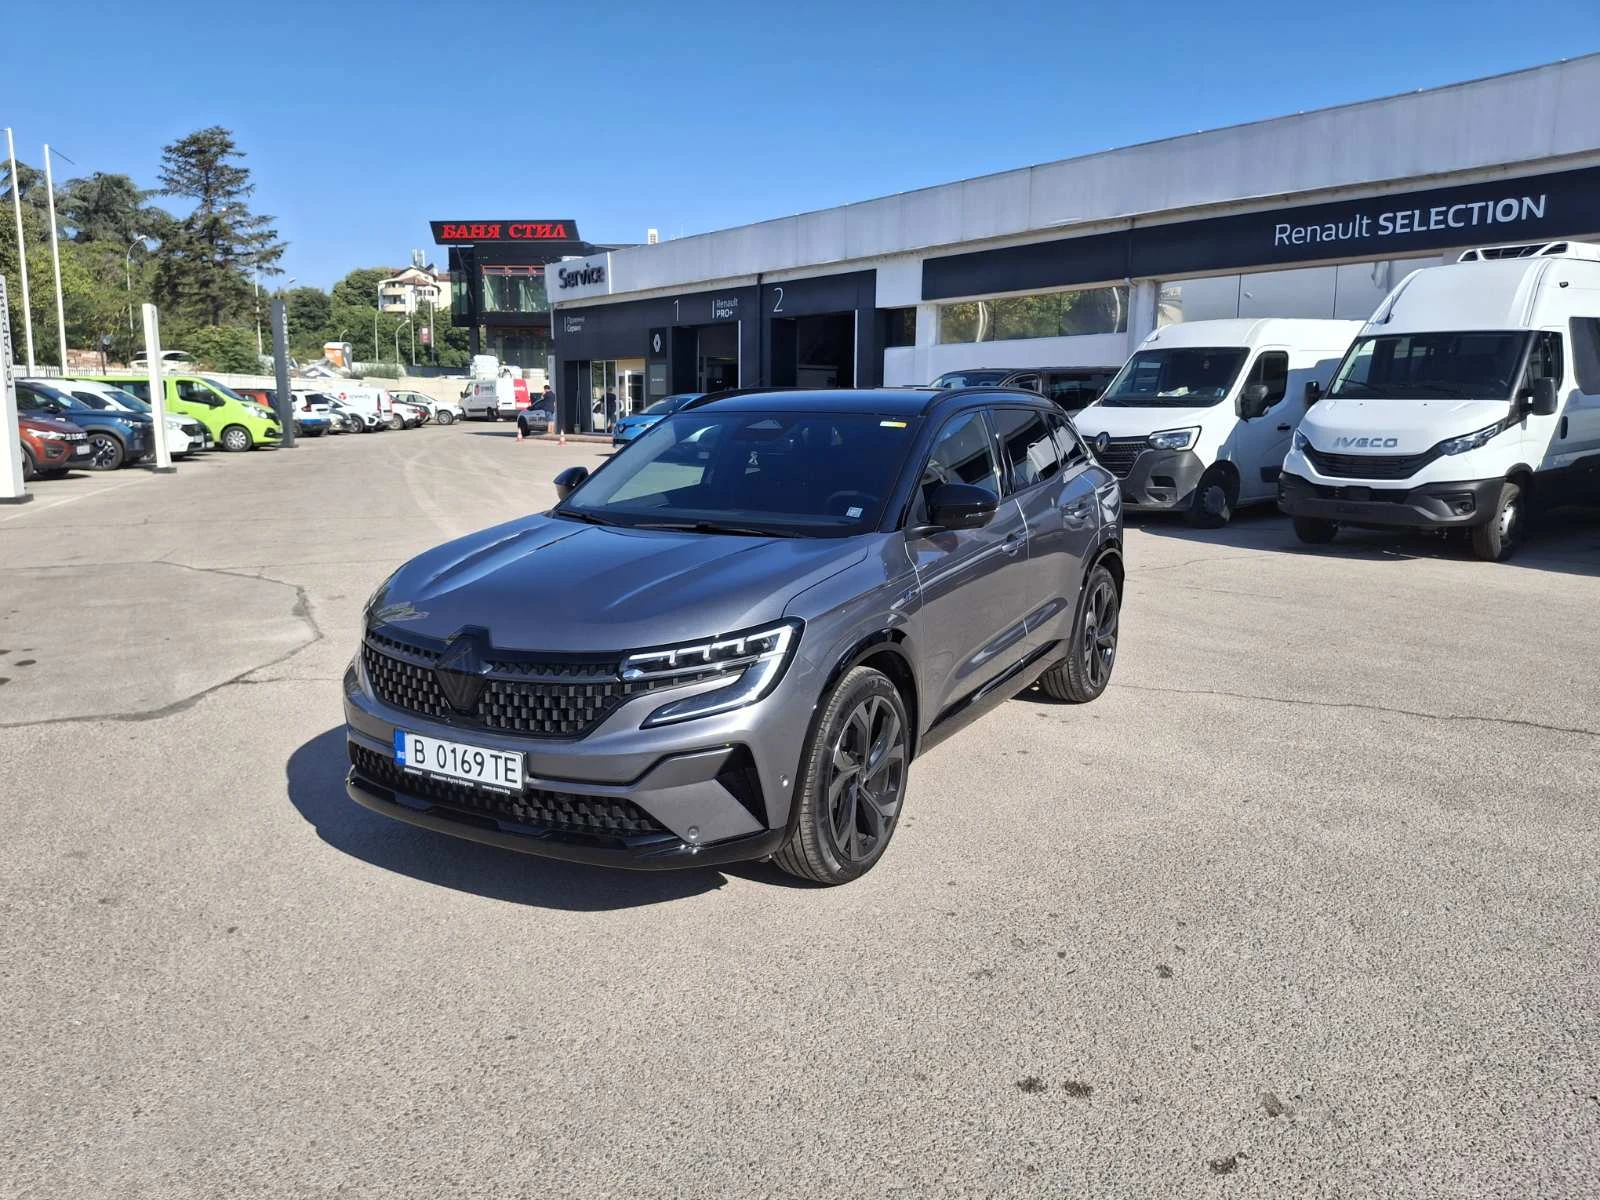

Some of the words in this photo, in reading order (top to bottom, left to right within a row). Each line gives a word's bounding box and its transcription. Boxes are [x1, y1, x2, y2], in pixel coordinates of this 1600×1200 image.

[441, 224, 501, 239] БАНЯ
[508, 223, 567, 239] СТИЛ
[1274, 214, 1372, 246] Renault
[1377, 194, 1546, 237] SELECTION
[558, 263, 606, 289] Service
[673, 299, 679, 321] 1
[716, 297, 739, 309] Renault
[773, 287, 784, 313] 2
[716, 308, 733, 319] PRO+
[1333, 436, 1398, 448] IVECO
[414, 739, 426, 764] B
